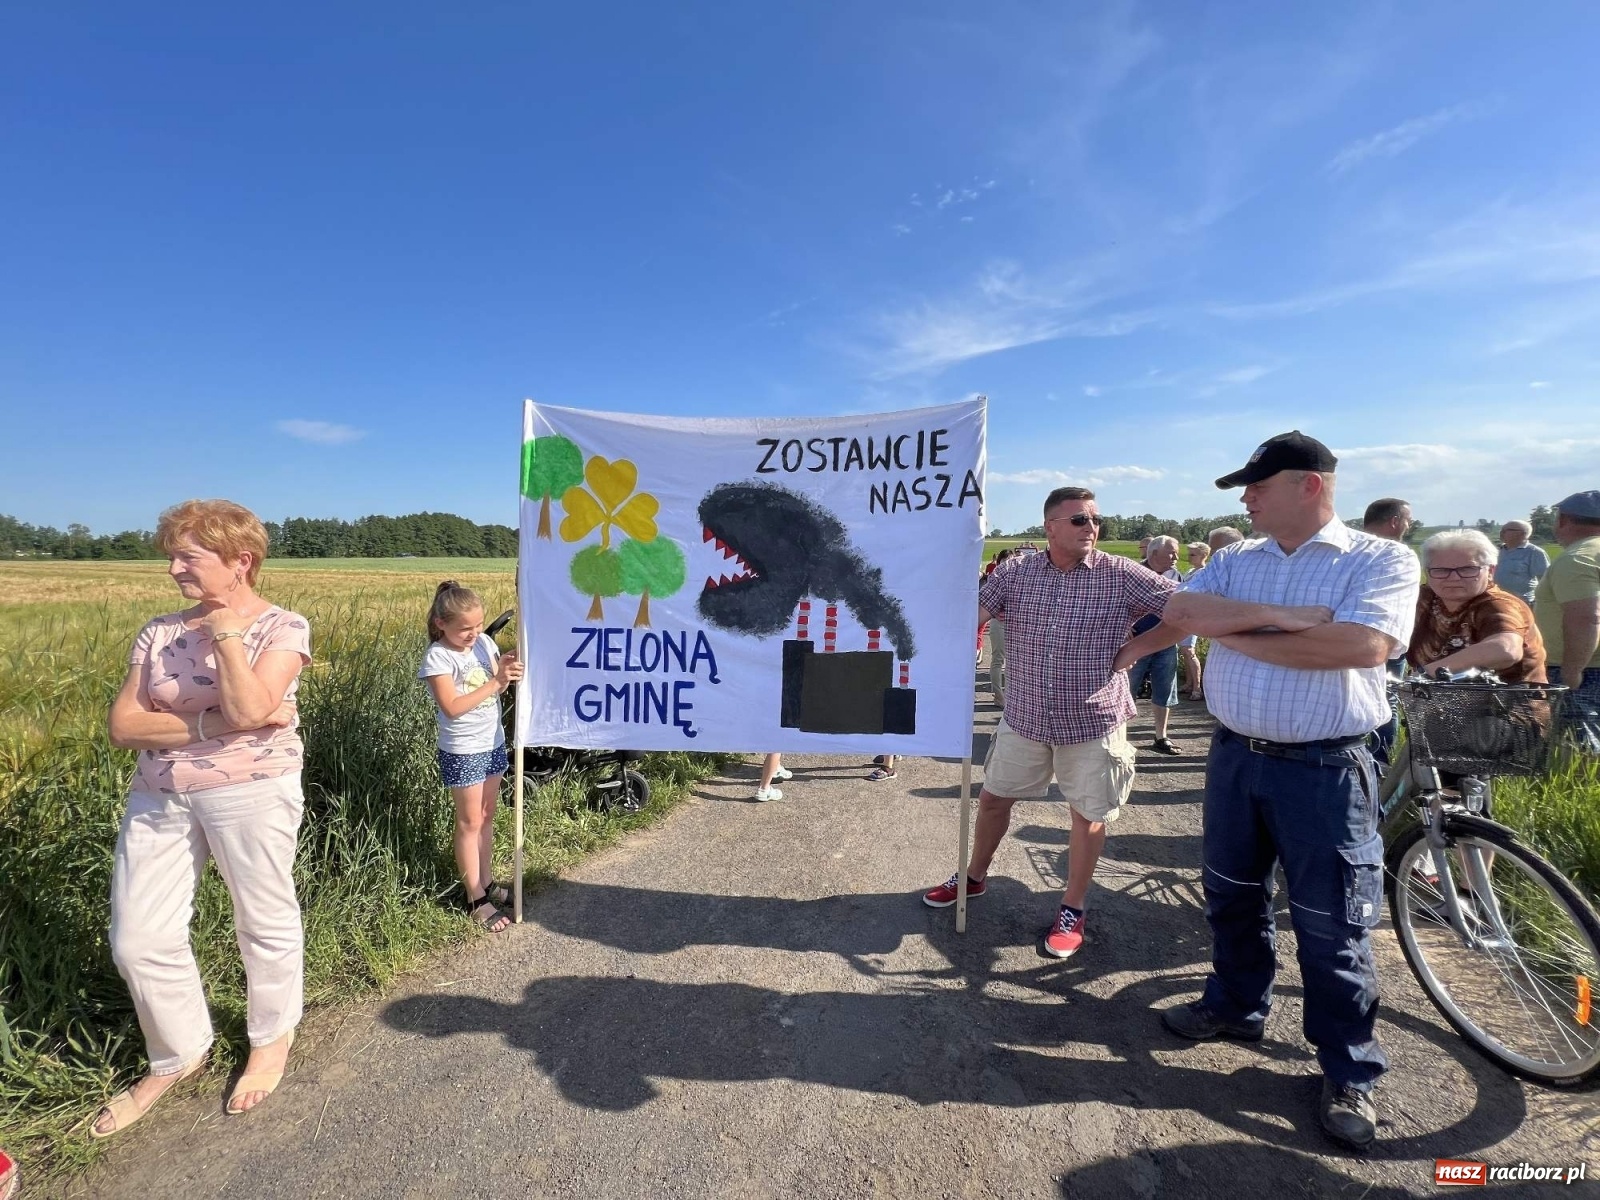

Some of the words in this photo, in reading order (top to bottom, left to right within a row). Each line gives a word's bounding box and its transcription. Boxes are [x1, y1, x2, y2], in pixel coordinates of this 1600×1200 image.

[756, 429, 949, 473] ZOSTAWCIE
[566, 627, 721, 684] ZIELONĄ
[574, 681, 698, 738] GMINĘ
